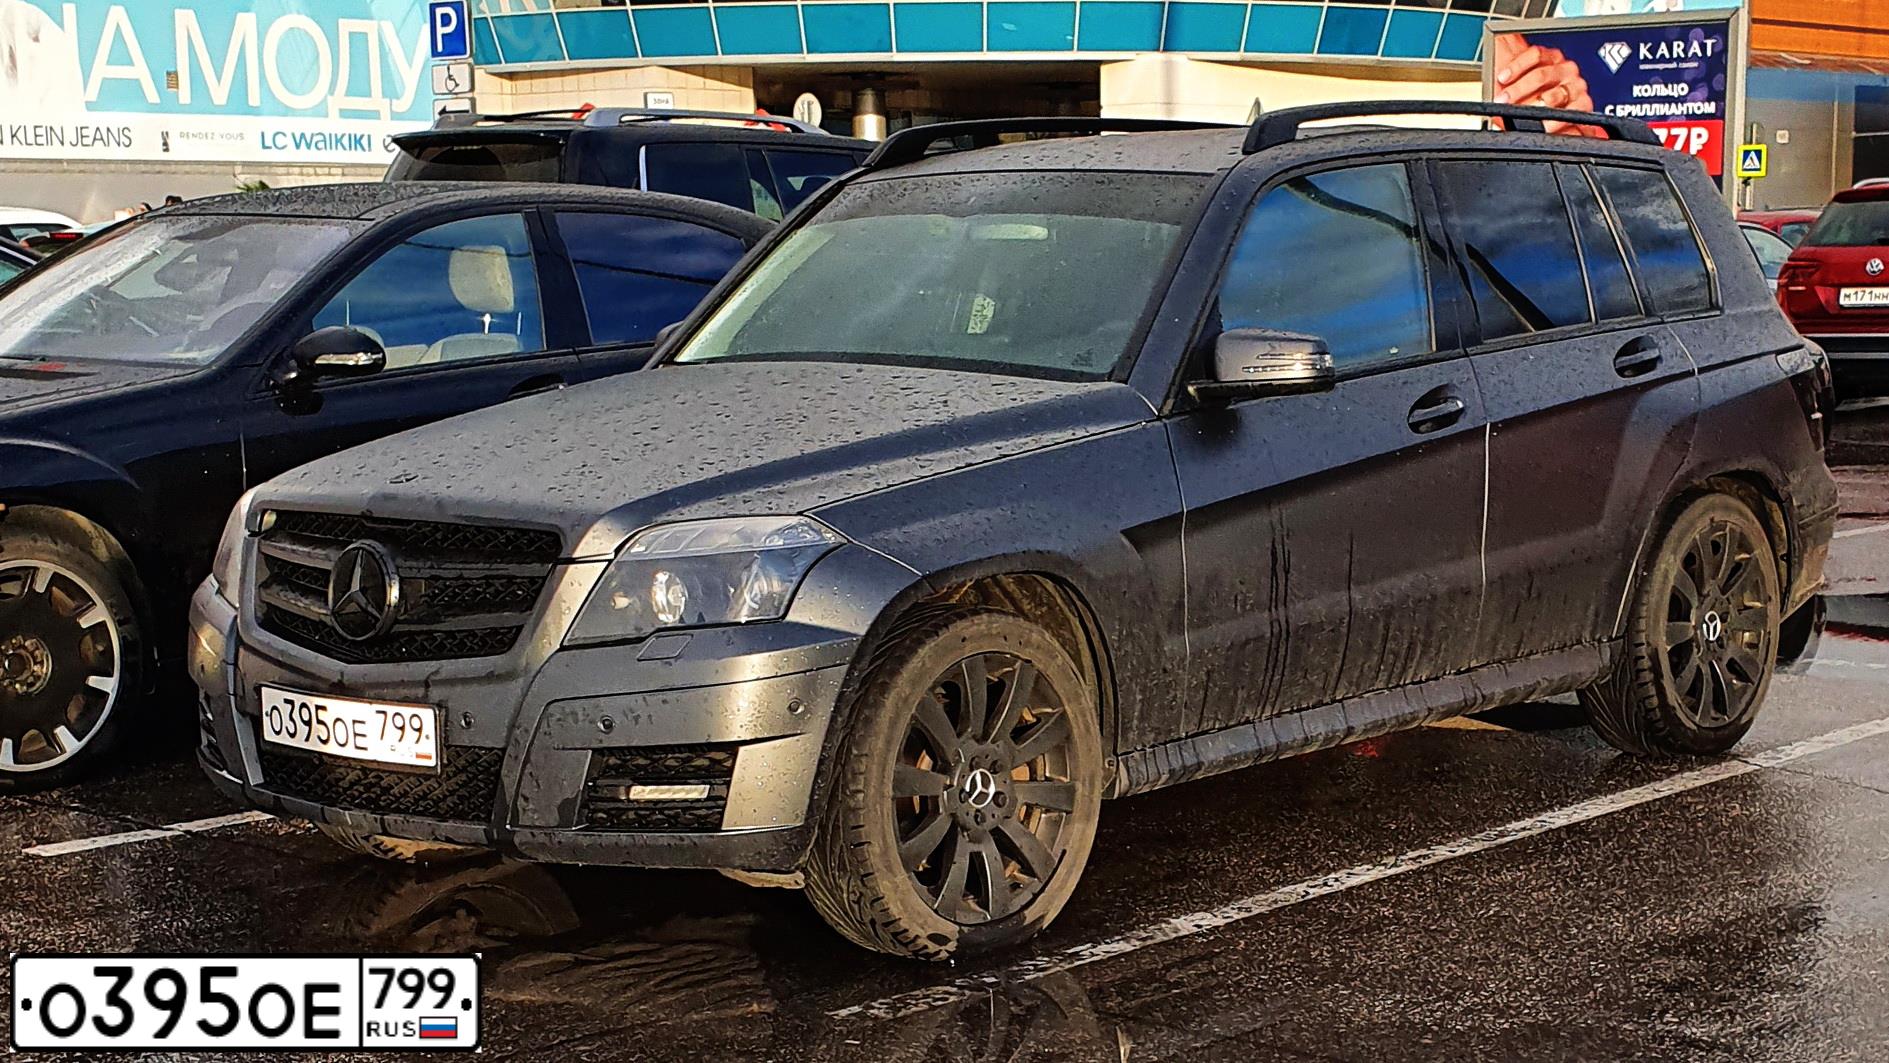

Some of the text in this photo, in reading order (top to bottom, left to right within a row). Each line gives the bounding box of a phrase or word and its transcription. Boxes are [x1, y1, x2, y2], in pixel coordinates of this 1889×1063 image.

[1638, 38, 1718, 61] KARAT
[173, 8, 430, 121] МОДУ
[1632, 82, 1689, 98] КОЛЬЦО
[1604, 101, 1716, 117] С БРИЛЛИАНТОМ
[9, 124, 65, 147] KLEIN
[69, 125, 133, 148] JEANS
[179, 130, 245, 141] RENDEZ VOUS
[260, 131, 287, 151] LC
[269, 698, 424, 751] О395ОЕ 799
